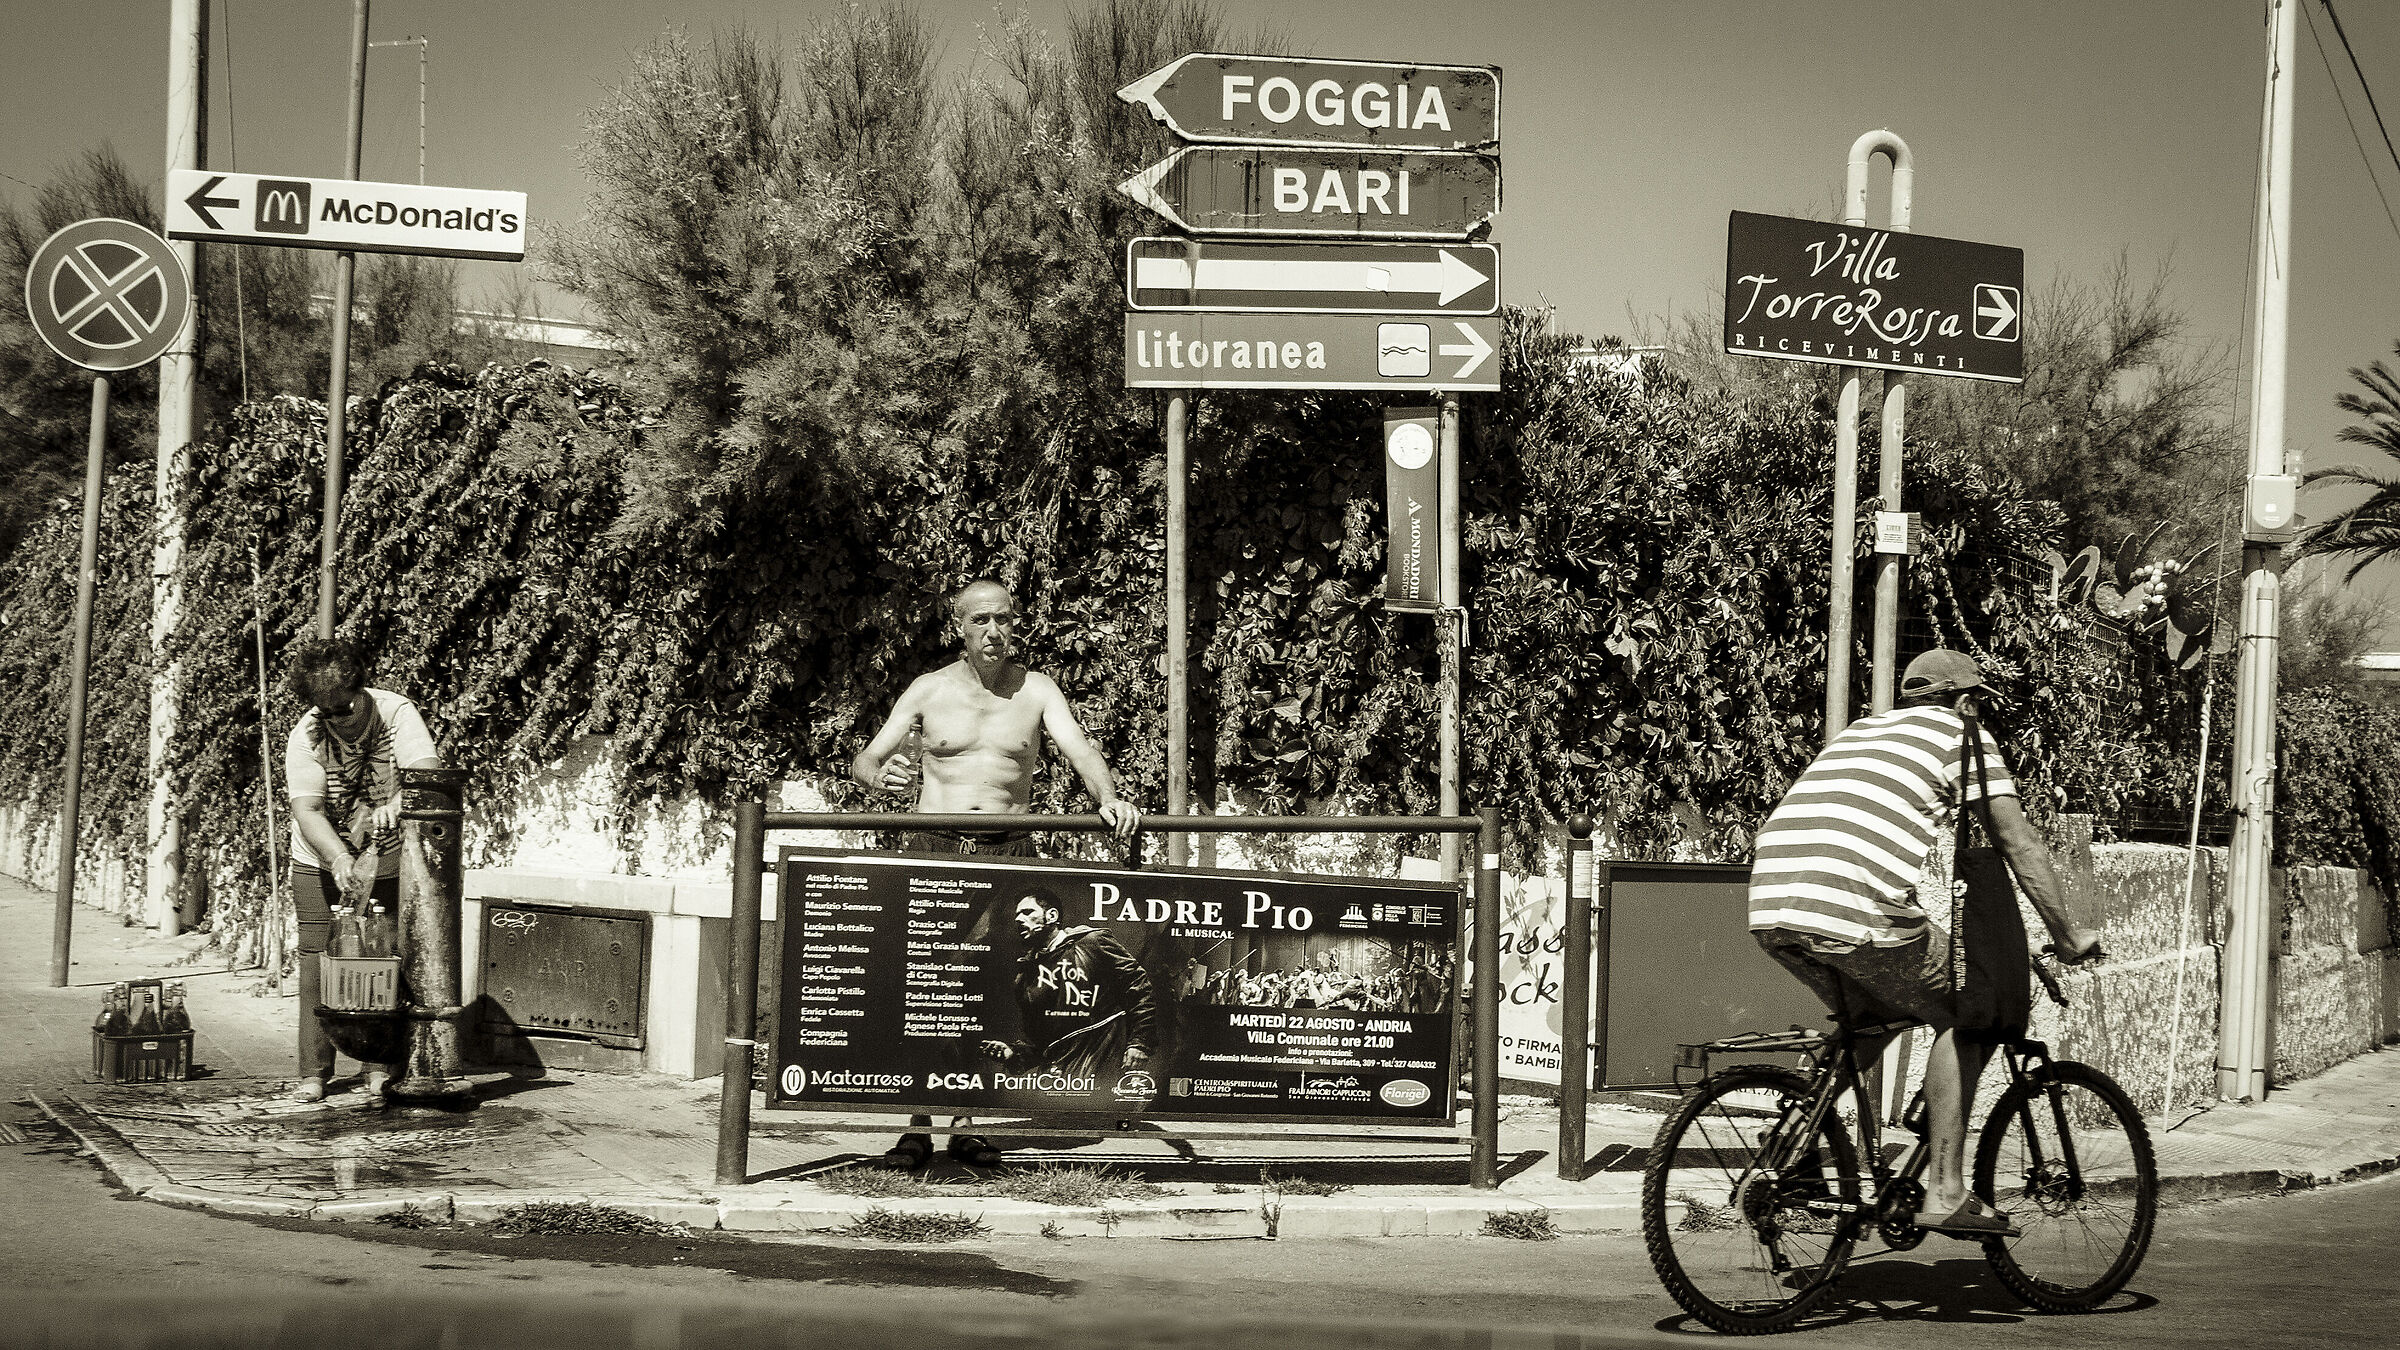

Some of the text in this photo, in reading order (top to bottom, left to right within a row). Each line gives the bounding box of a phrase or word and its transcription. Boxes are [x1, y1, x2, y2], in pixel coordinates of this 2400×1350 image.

[1222, 75, 1451, 131] FOGGIA
[1273, 168, 1410, 215] BARI
[320, 198, 518, 233] McDonald's
[1805, 232, 1900, 285] Villa
[1137, 329, 1327, 370] litoranea
[1736, 334, 1965, 369] RICEVIMENTI
[1410, 518, 1421, 600] MONDADORI
[806, 874, 868, 883] Attilio Fontana
[910, 878, 992, 888] Mariagrazia Fontana
[805, 902, 883, 912] Maurizio Semeraro
[909, 899, 970, 909] Attilio Fontana
[1089, 882, 1313, 931] PADRE PIO
[804, 923, 875, 932] Luciana Bottalico
[908, 920, 936, 928] Orazio
[1171, 928, 1234, 939] IL MUSICAL
[803, 944, 870, 953] Antonio Melissa
[907, 941, 991, 951] Maria Grazia Nicotra
[803, 965, 866, 974] Luigi Ciavarella
[906, 962, 980, 972] Stanislao Cantono
[906, 971, 938, 979] di Ceva
[802, 986, 866, 995] Carlotta Pistillo
[905, 992, 984, 1002] Padre Luciano Lotti
[801, 1007, 865, 1016] Enrica Cassetta
[904, 1013, 937, 1021] Michele
[938, 1014, 970, 1022] Lorusso
[904, 1022, 984, 1031] Agnese Paola Festa
[1230, 1013, 1287, 1028] MARTEDÌ
[1288, 1016, 1304, 1029] 22
[1305, 1017, 1355, 1031] AGOSTO
[1364, 1019, 1413, 1033] ANDRIA
[800, 1029, 848, 1038] Compagnia
[800, 1038, 848, 1046] Federiciana
[1247, 1031, 1394, 1049] Villa Comunale ore 21.00
[1199, 1053, 1239, 1062] Accademia
[1241, 1054, 1272, 1063] Musicale
[1273, 1056, 1314, 1064] Federiciana
[1362, 1059, 1375, 1067] 309
[1393, 1060, 1407, 1068] 327
[811, 1069, 913, 1087] Matarrese
[943, 1073, 984, 1090] CSA
[994, 1072, 1095, 1091] PartiColori
[1384, 1087, 1426, 1101] Florigel
